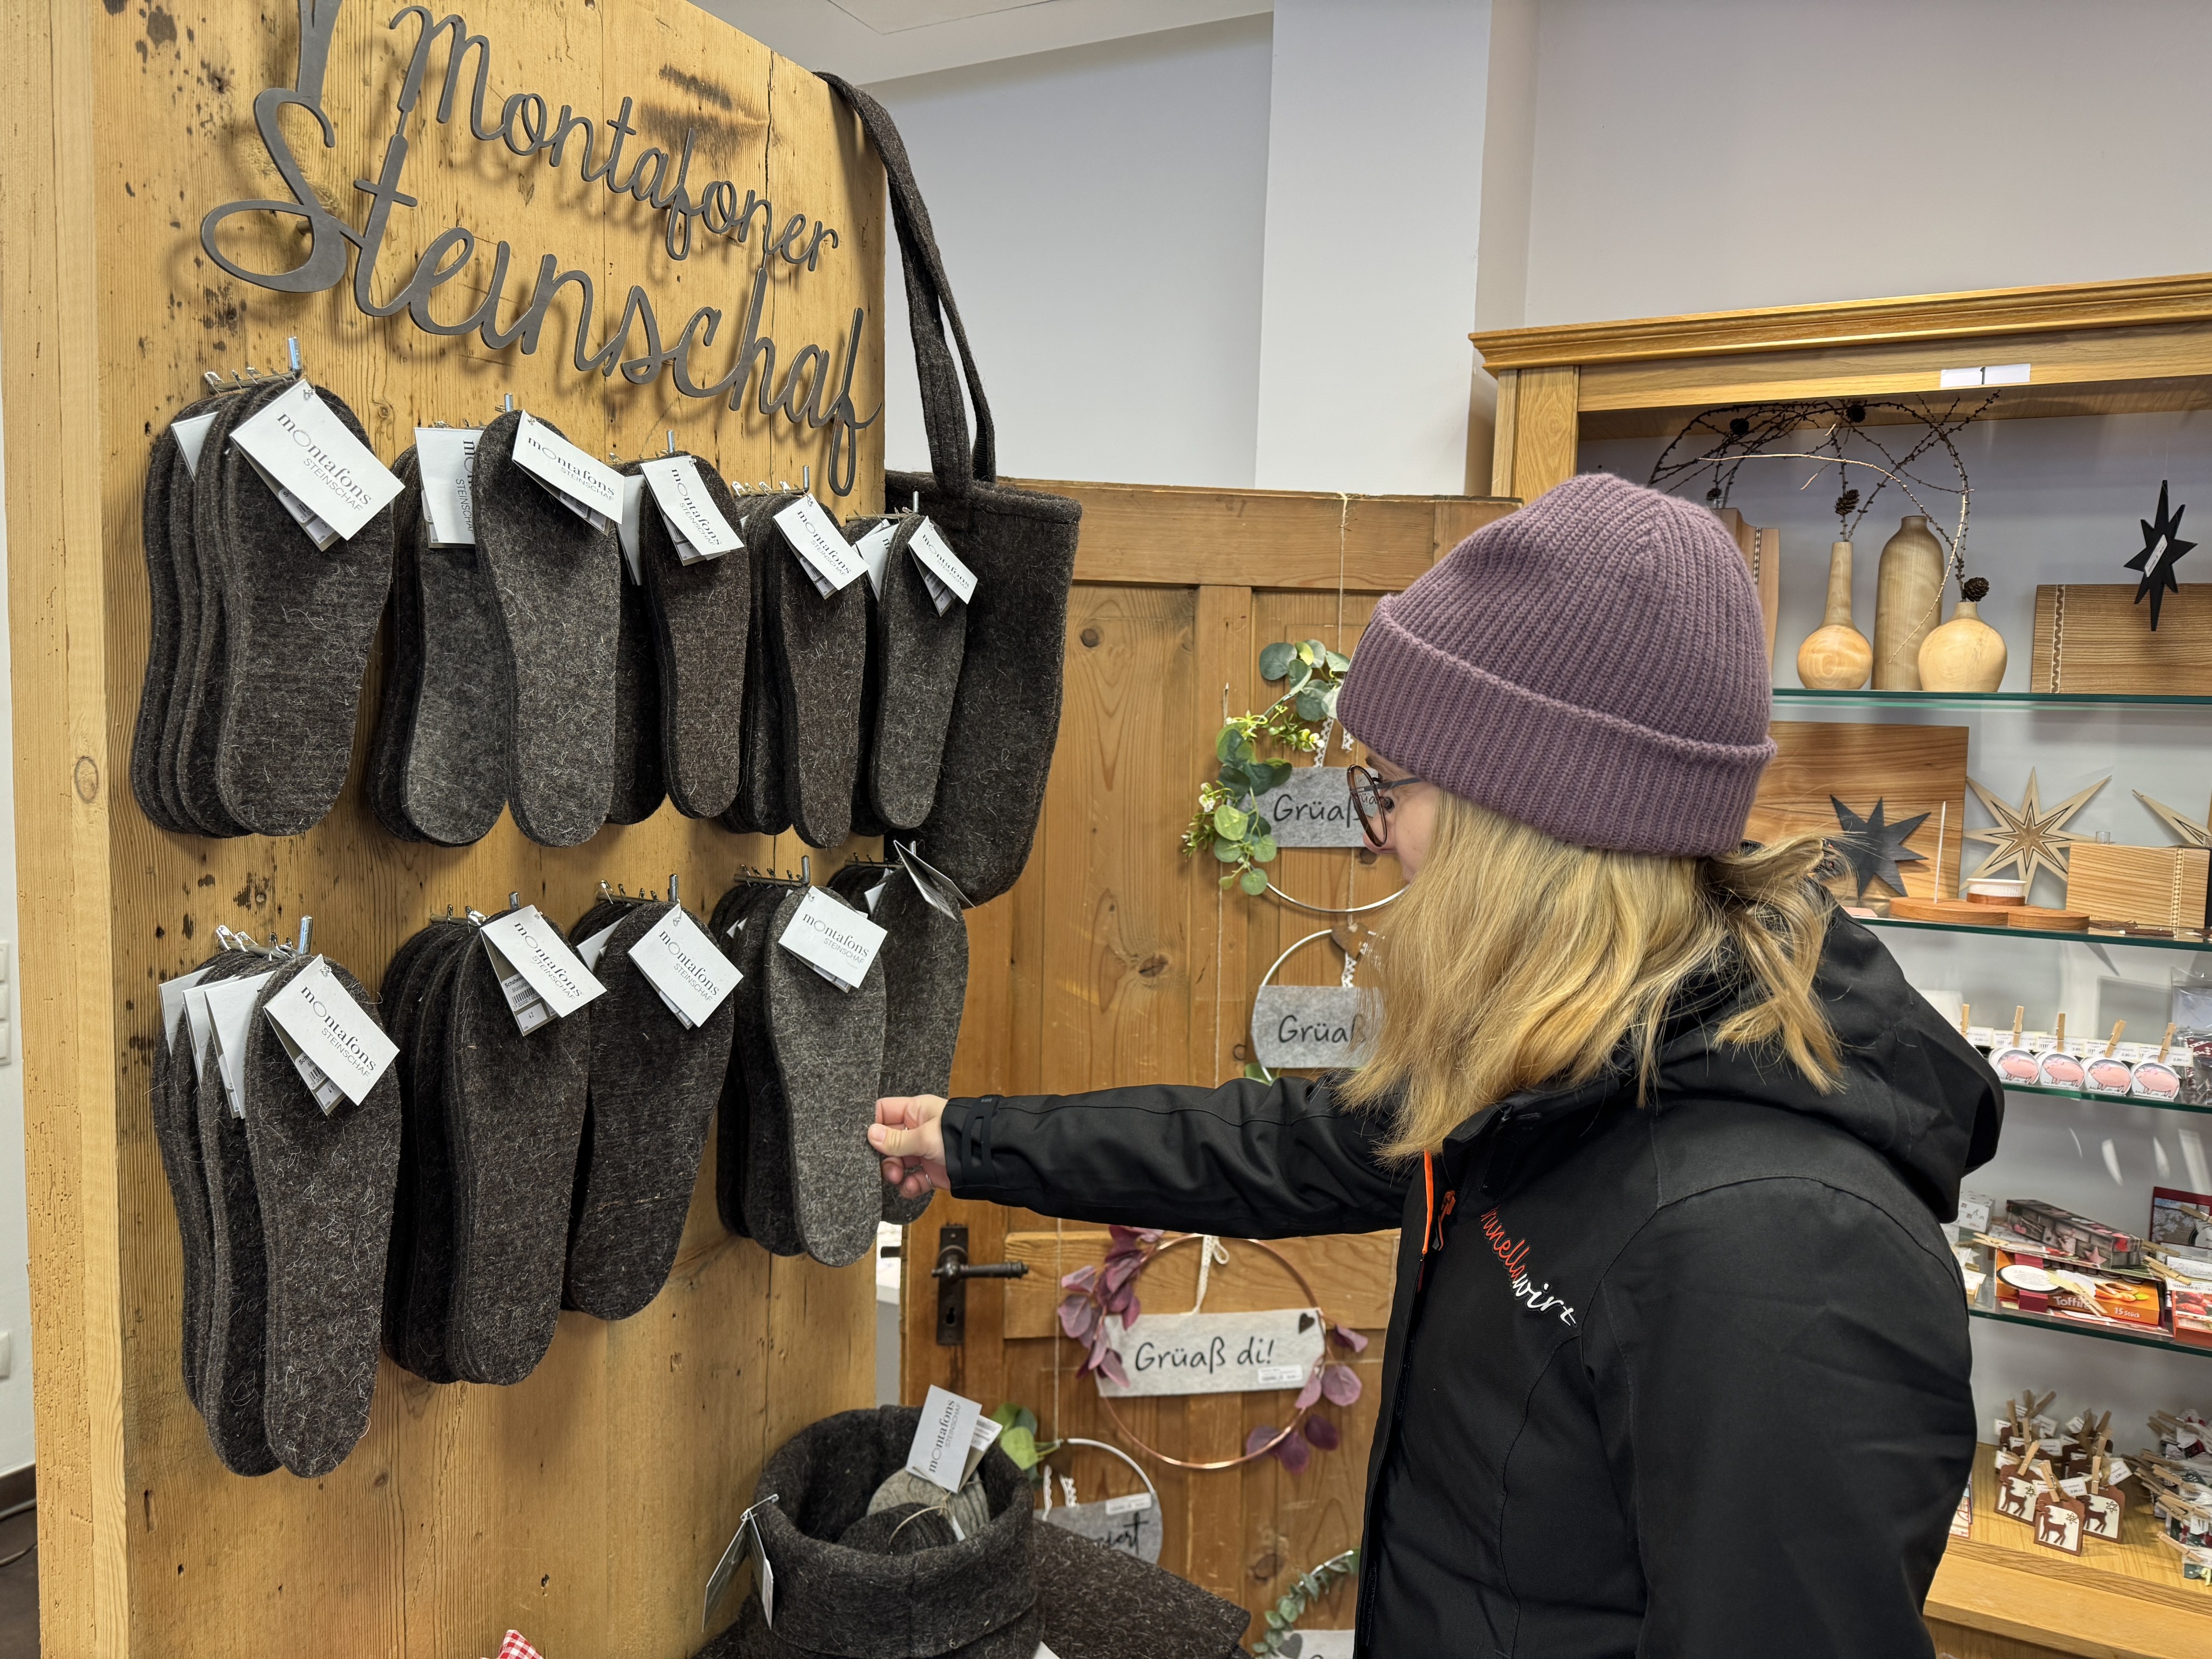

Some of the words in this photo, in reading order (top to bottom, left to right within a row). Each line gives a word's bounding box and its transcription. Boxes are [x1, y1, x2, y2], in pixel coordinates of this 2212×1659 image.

[390, 5, 839, 272] Montafoner
[200, 88, 882, 496] Steinschaf
[304, 458, 362, 511] STEINSCHAF
[561, 467, 615, 501] STEINSCHAF
[679, 503, 716, 547] STEINSCHAF
[811, 540, 846, 576] STEINSCHAF
[937, 560, 969, 590] STEINSCHAF
[824, 938, 864, 964] STEINSCHAF
[532, 955, 576, 1000] STEINSCHAF
[674, 963, 713, 1001] STEINSCHAF
[321, 1028, 370, 1078] STEINSCHAF
[2114, 1307, 2123, 1315] 15
[1135, 1337, 1225, 1374] Grüaß
[1237, 1336, 1274, 1365] di!
